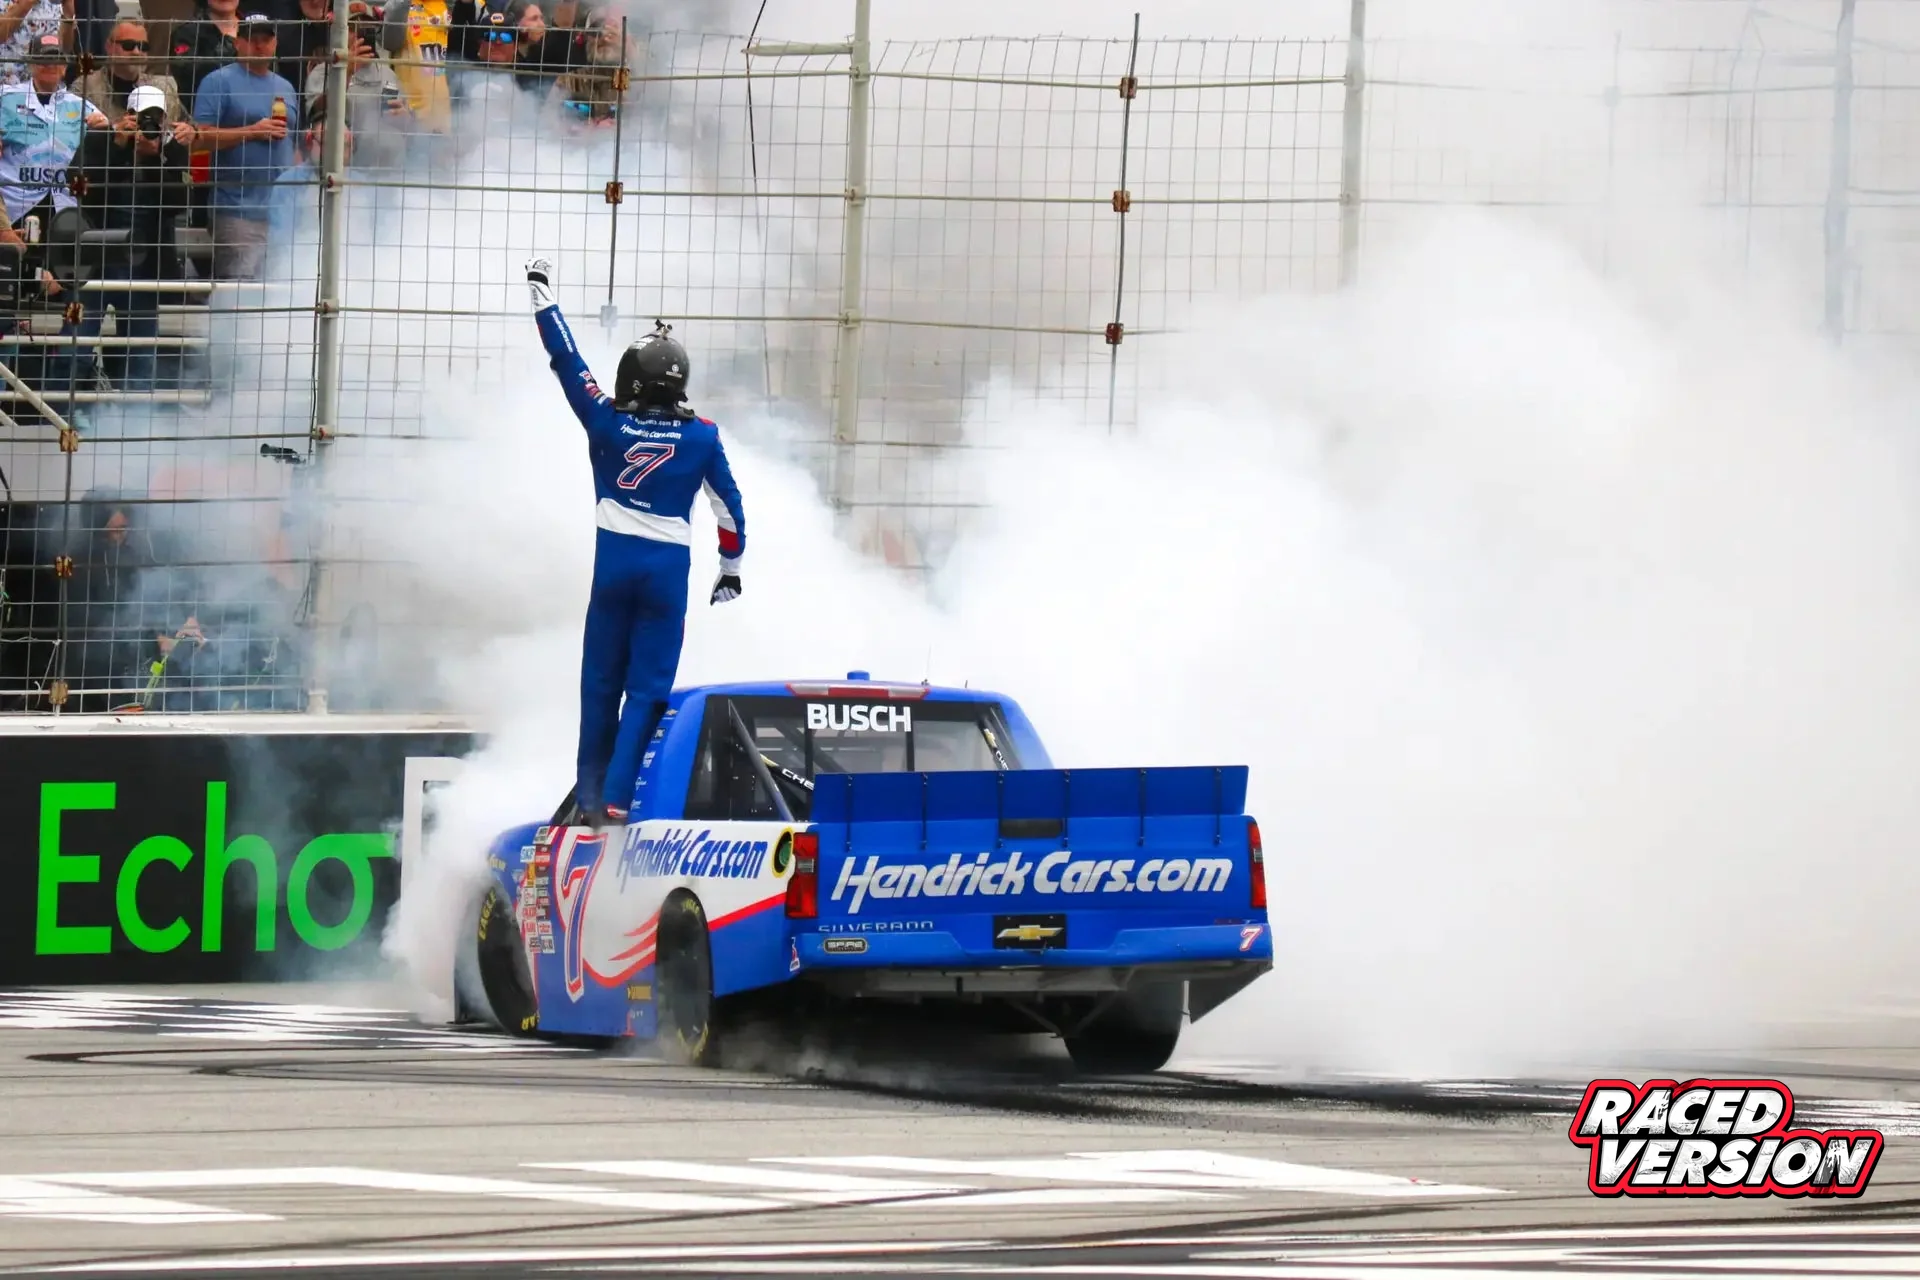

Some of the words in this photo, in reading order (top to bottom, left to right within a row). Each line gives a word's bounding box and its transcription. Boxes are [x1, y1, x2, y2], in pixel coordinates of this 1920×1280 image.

[20, 167, 67, 184] BUSC
[617, 442, 675, 489] 7
[807, 703, 912, 732] BUSCH
[561, 833, 608, 1003] 7
[1240, 925, 1263, 951] 7
